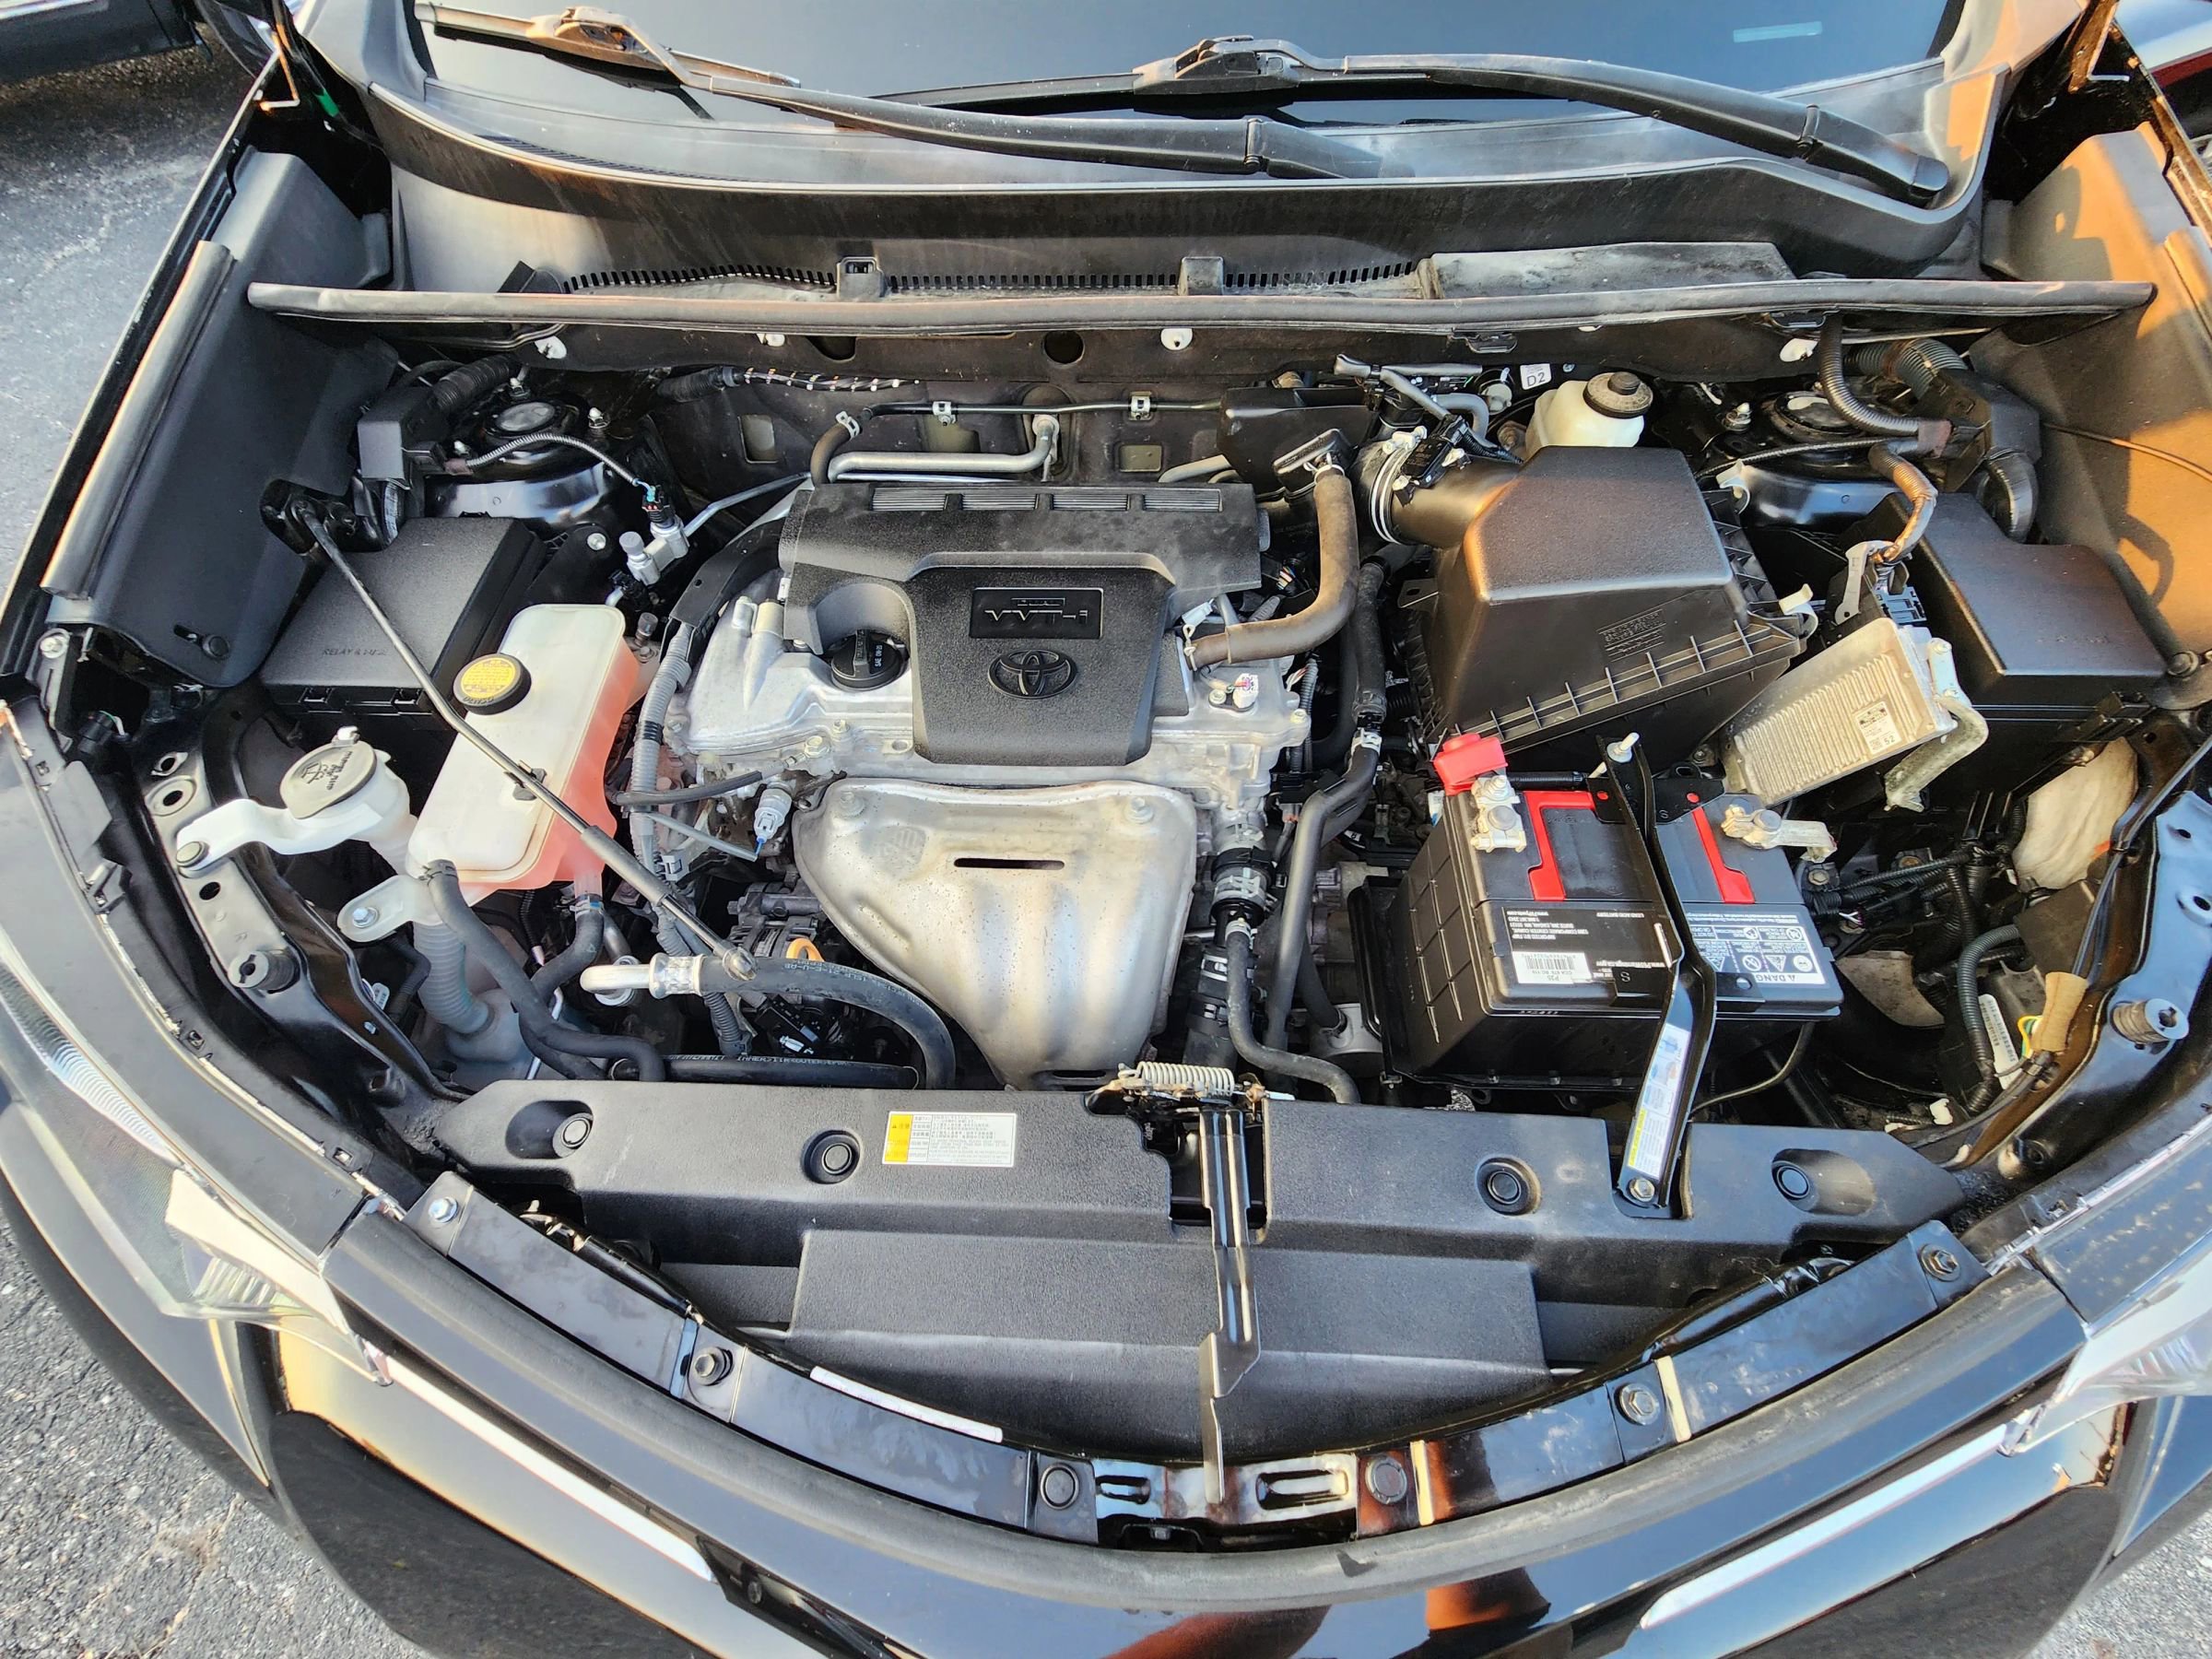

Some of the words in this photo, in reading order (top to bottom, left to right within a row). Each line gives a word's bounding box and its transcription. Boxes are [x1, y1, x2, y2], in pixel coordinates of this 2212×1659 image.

[1526, 371, 1546, 387] D2
[874, 658, 882, 667] SAE
[1884, 735, 1896, 745] 52
